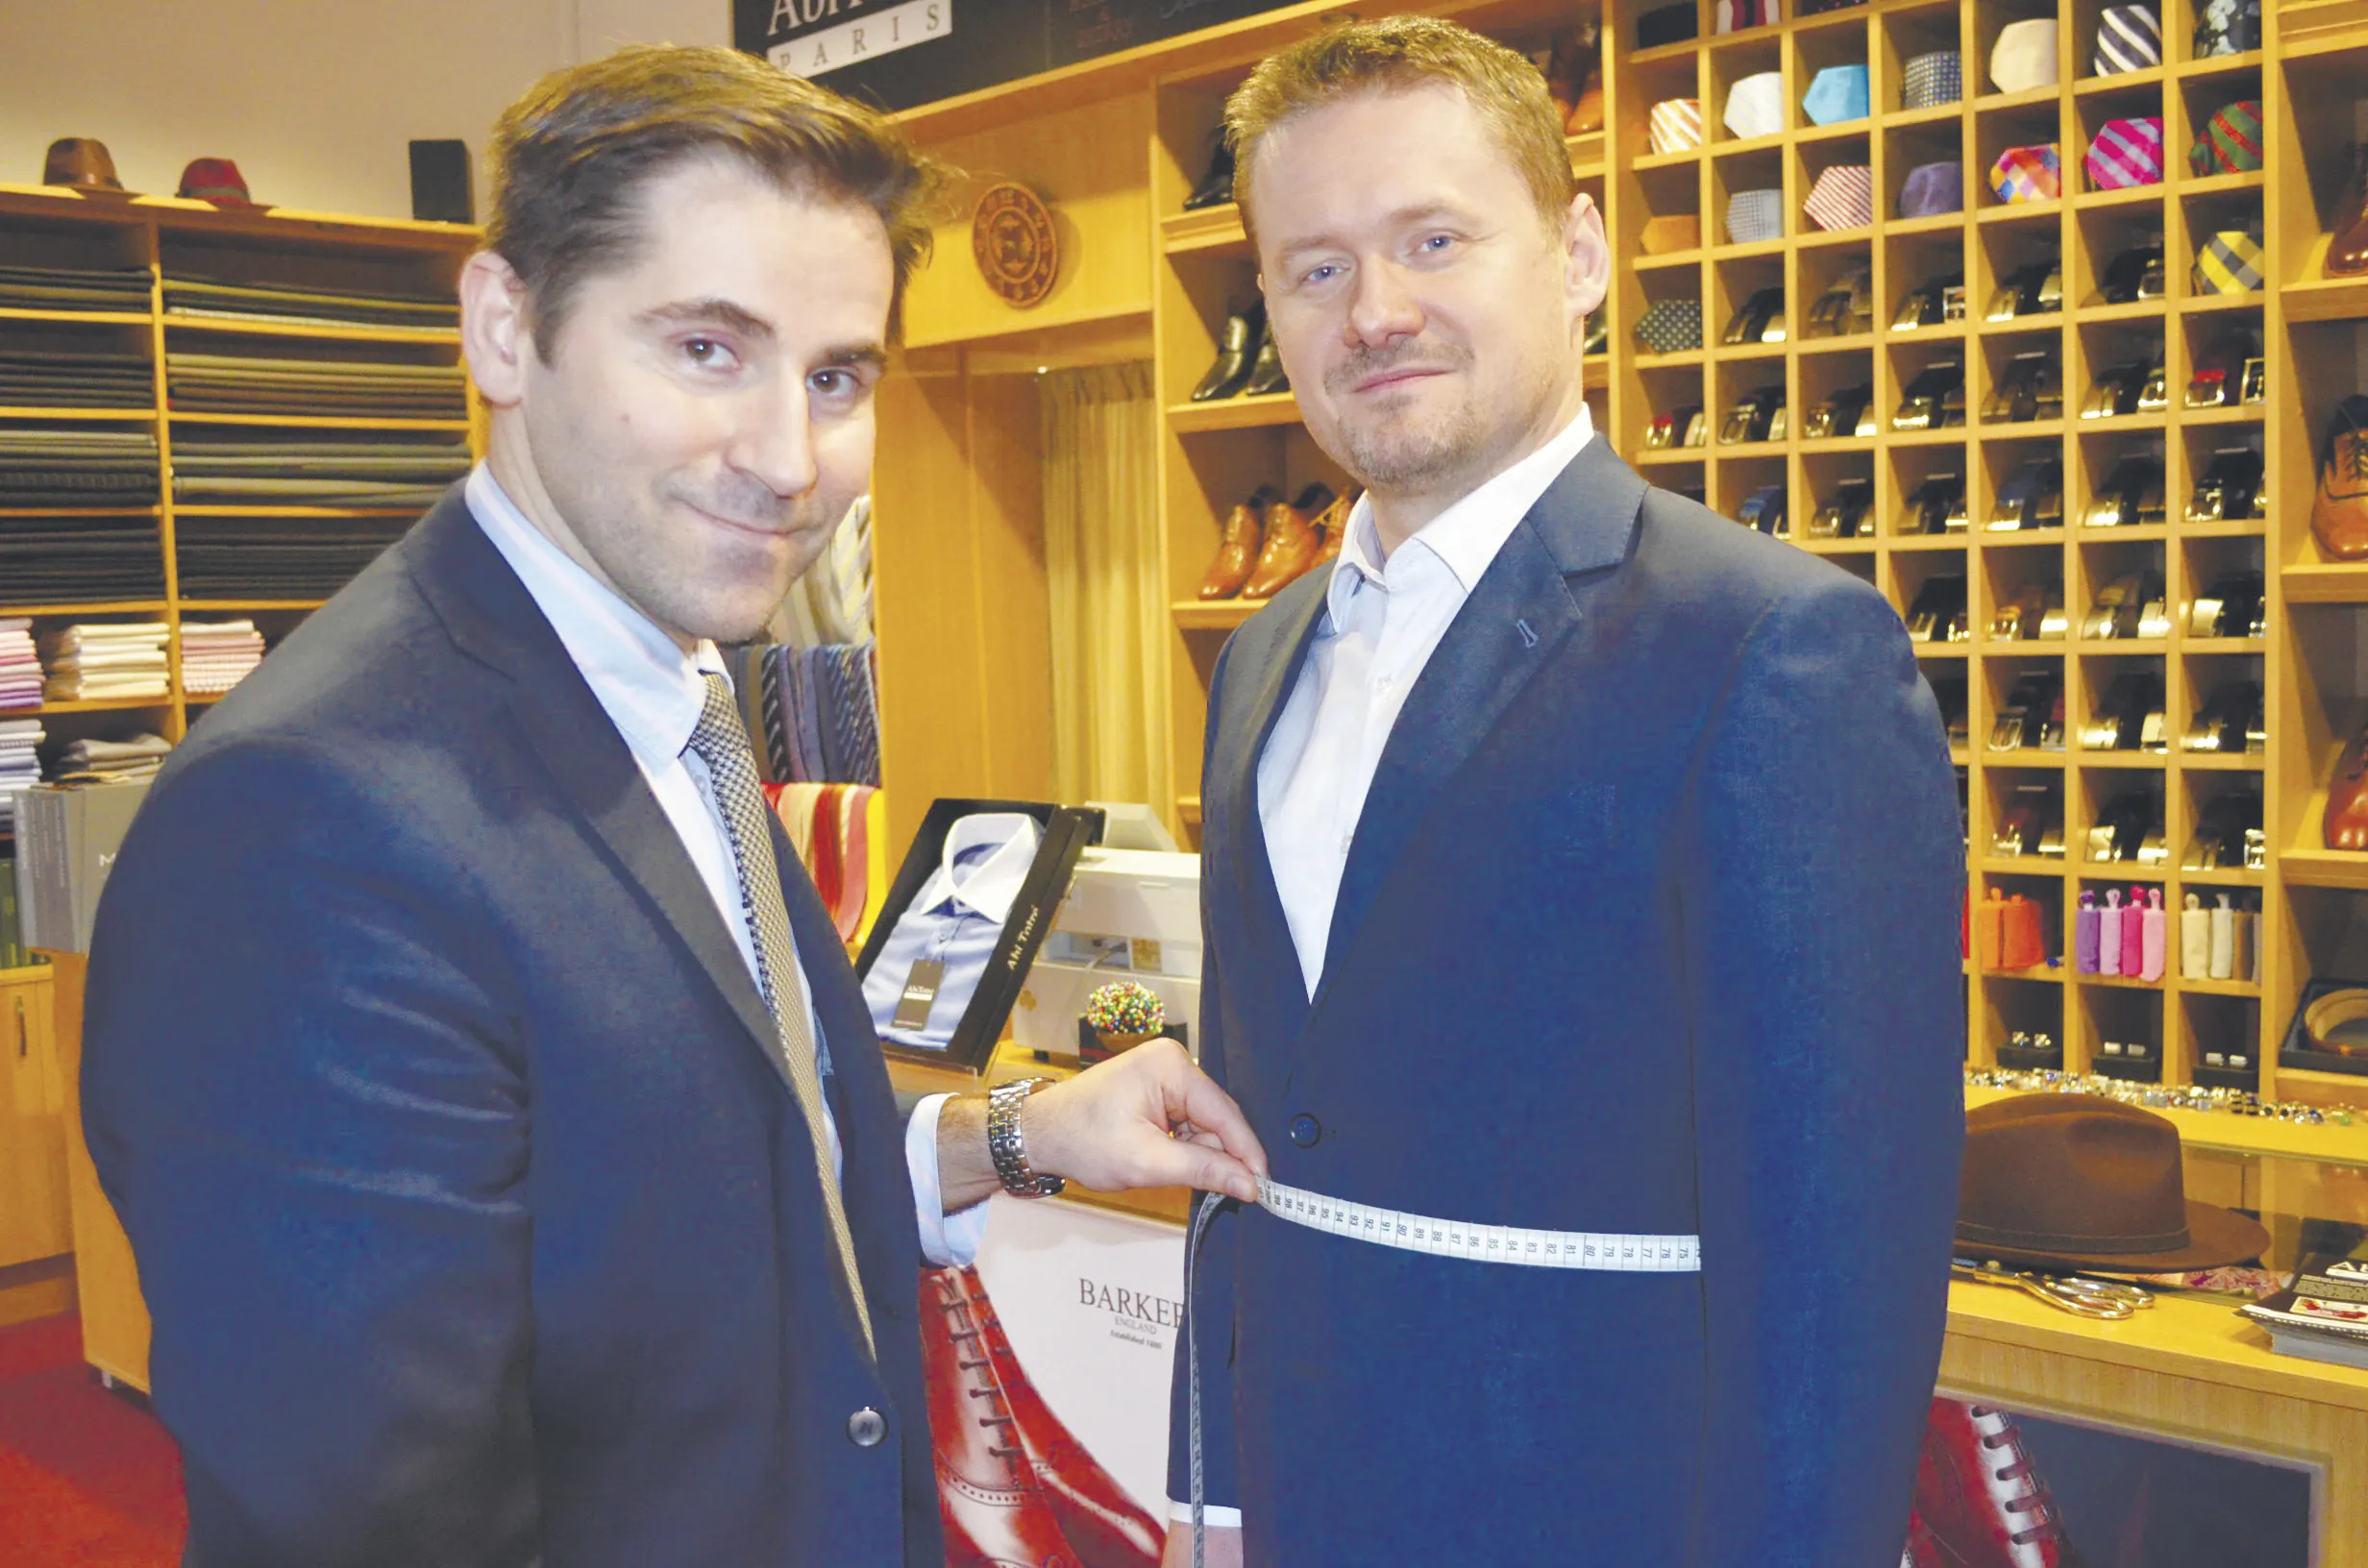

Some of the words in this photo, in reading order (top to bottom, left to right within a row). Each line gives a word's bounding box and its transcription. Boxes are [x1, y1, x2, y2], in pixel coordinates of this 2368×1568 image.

[779, 4, 939, 68] PARIS
[1309, 1205, 1317, 1215] 96
[1321, 1208, 1329, 1218] 95
[1336, 1212, 1344, 1222] 94
[1349, 1214, 1359, 1226] 93
[1365, 1218, 1374, 1229] 92
[1380, 1221, 1391, 1232] 91
[1398, 1223, 1407, 1237] 90
[1415, 1228, 1424, 1238] 89
[1433, 1231, 1442, 1242] 88
[1451, 1233, 1461, 1244] 87
[1469, 1236, 1479, 1247] 86
[1489, 1237, 1498, 1249] 85
[1508, 1239, 1517, 1251] 84
[1527, 1241, 1538, 1253] 83
[1546, 1243, 1557, 1255] 82
[1566, 1244, 1576, 1255] 81
[1586, 1244, 1595, 1257] 80
[1604, 1246, 1615, 1258] 79
[1623, 1247, 1634, 1259] 78
[1642, 1247, 1653, 1259] 77
[1662, 1247, 1671, 1259] 76
[1679, 1247, 1689, 1259] 75
[1115, 1315, 1157, 1335] ENGLAND
